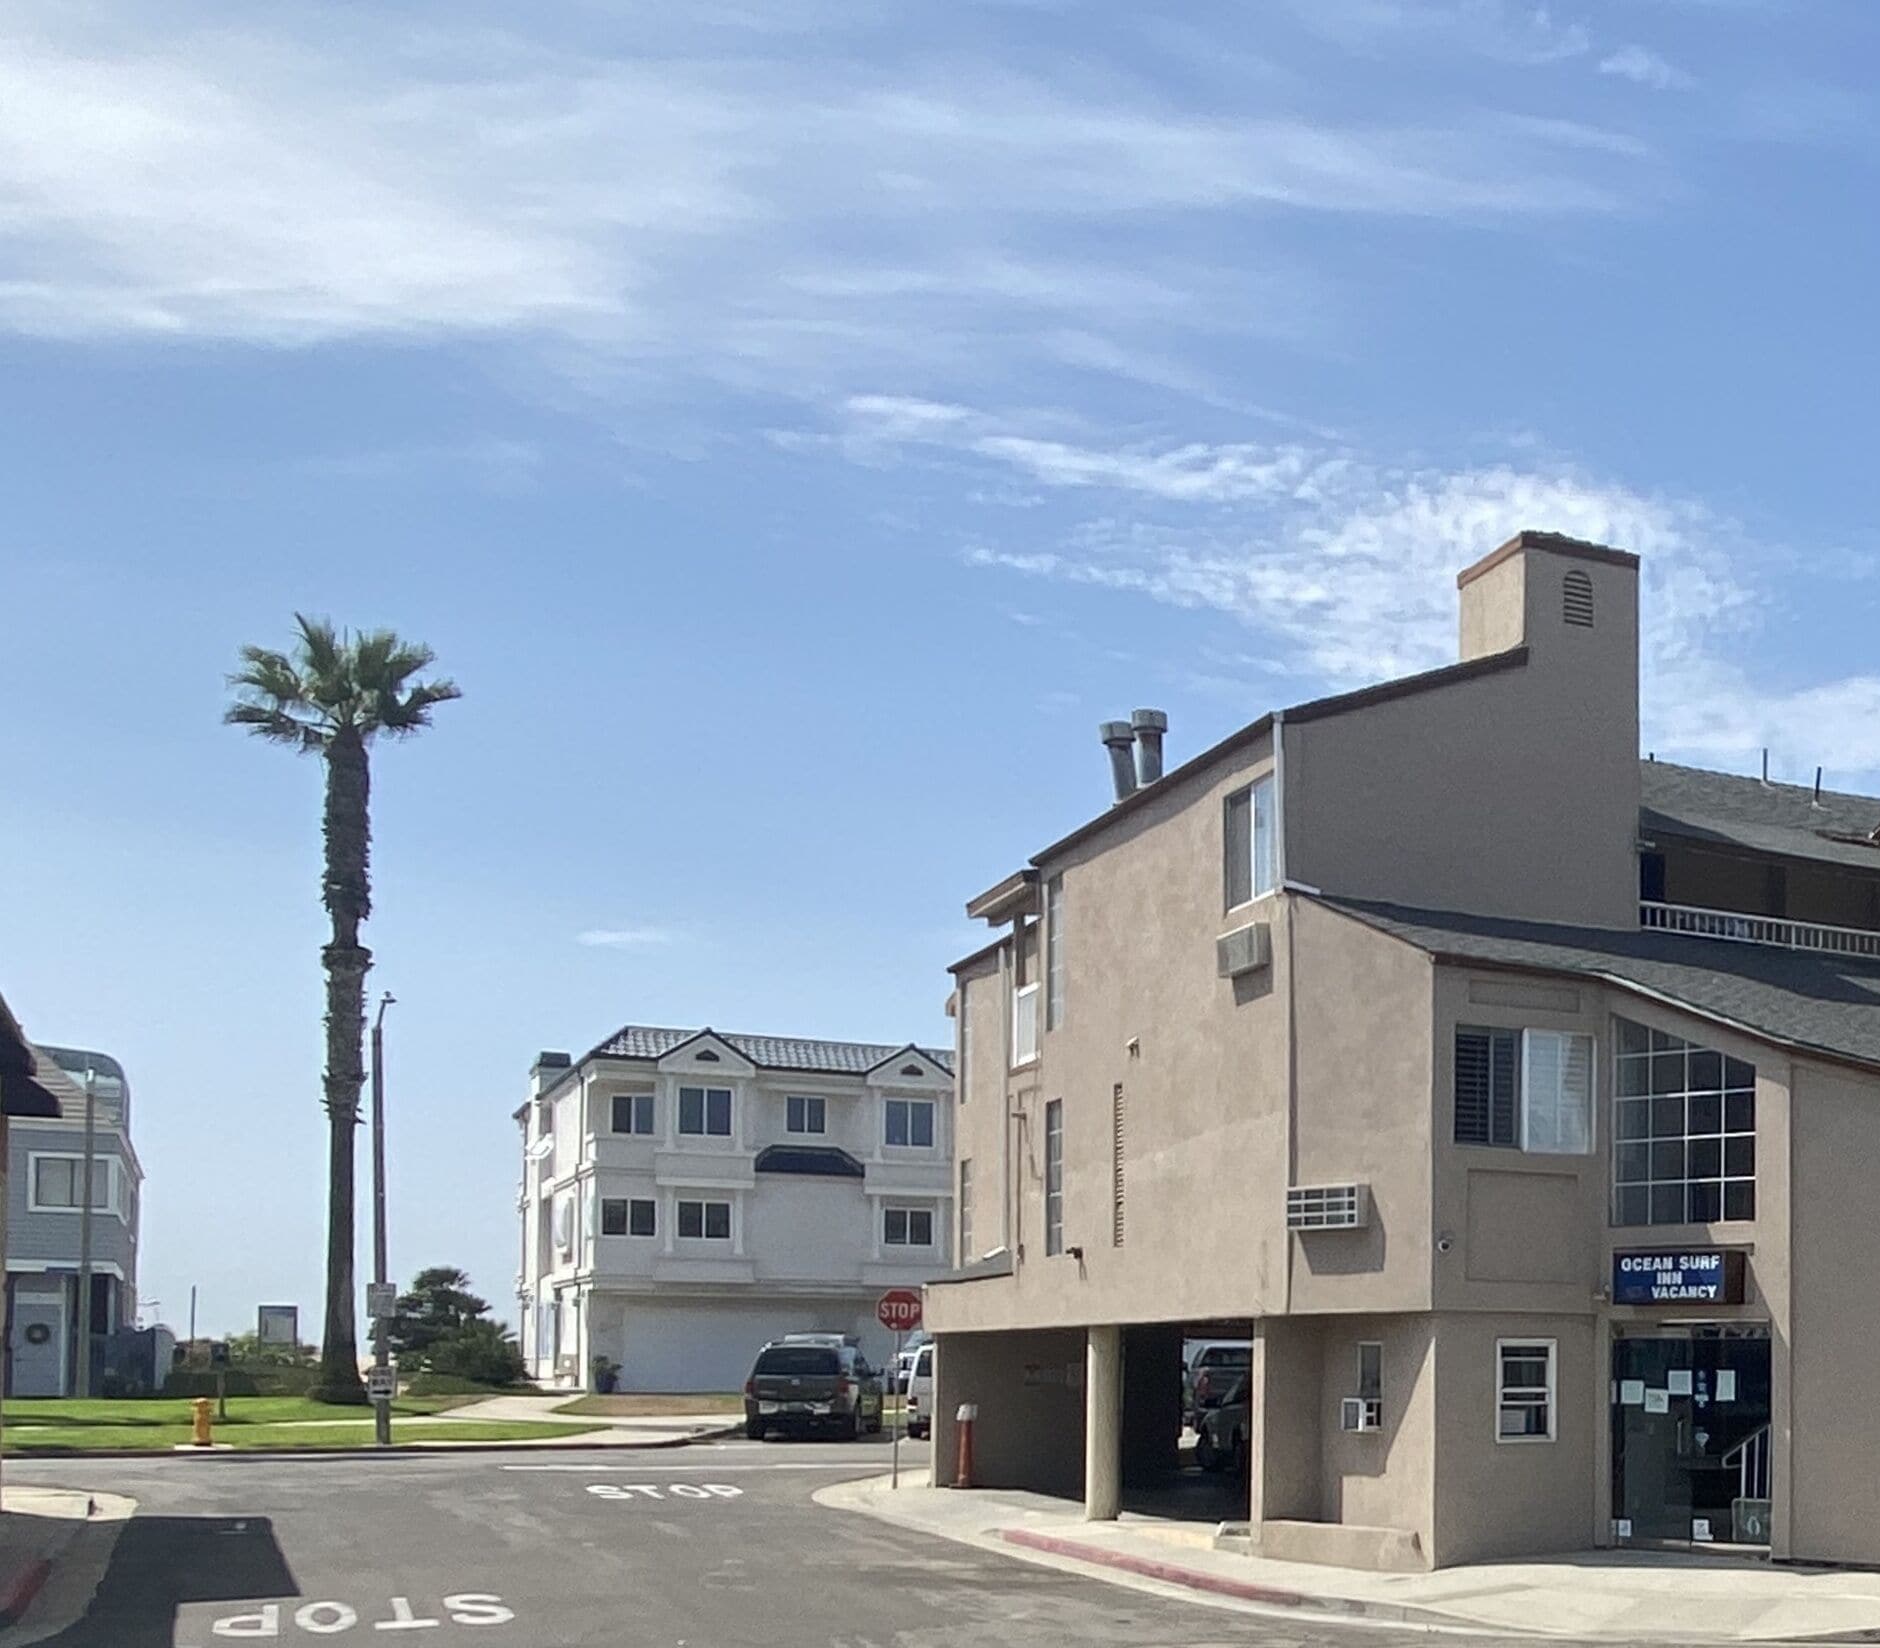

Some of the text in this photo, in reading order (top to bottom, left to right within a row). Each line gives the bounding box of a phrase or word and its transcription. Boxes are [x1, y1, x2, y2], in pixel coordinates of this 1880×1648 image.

[1620, 1254, 1720, 1271] OCEAN SURF
[1656, 1271, 1682, 1285] INN
[1651, 1284, 1718, 1299] VACANCY
[880, 1301, 920, 1319] STOP
[585, 1483, 744, 1500] STOP
[211, 1593, 515, 1638] STOP
